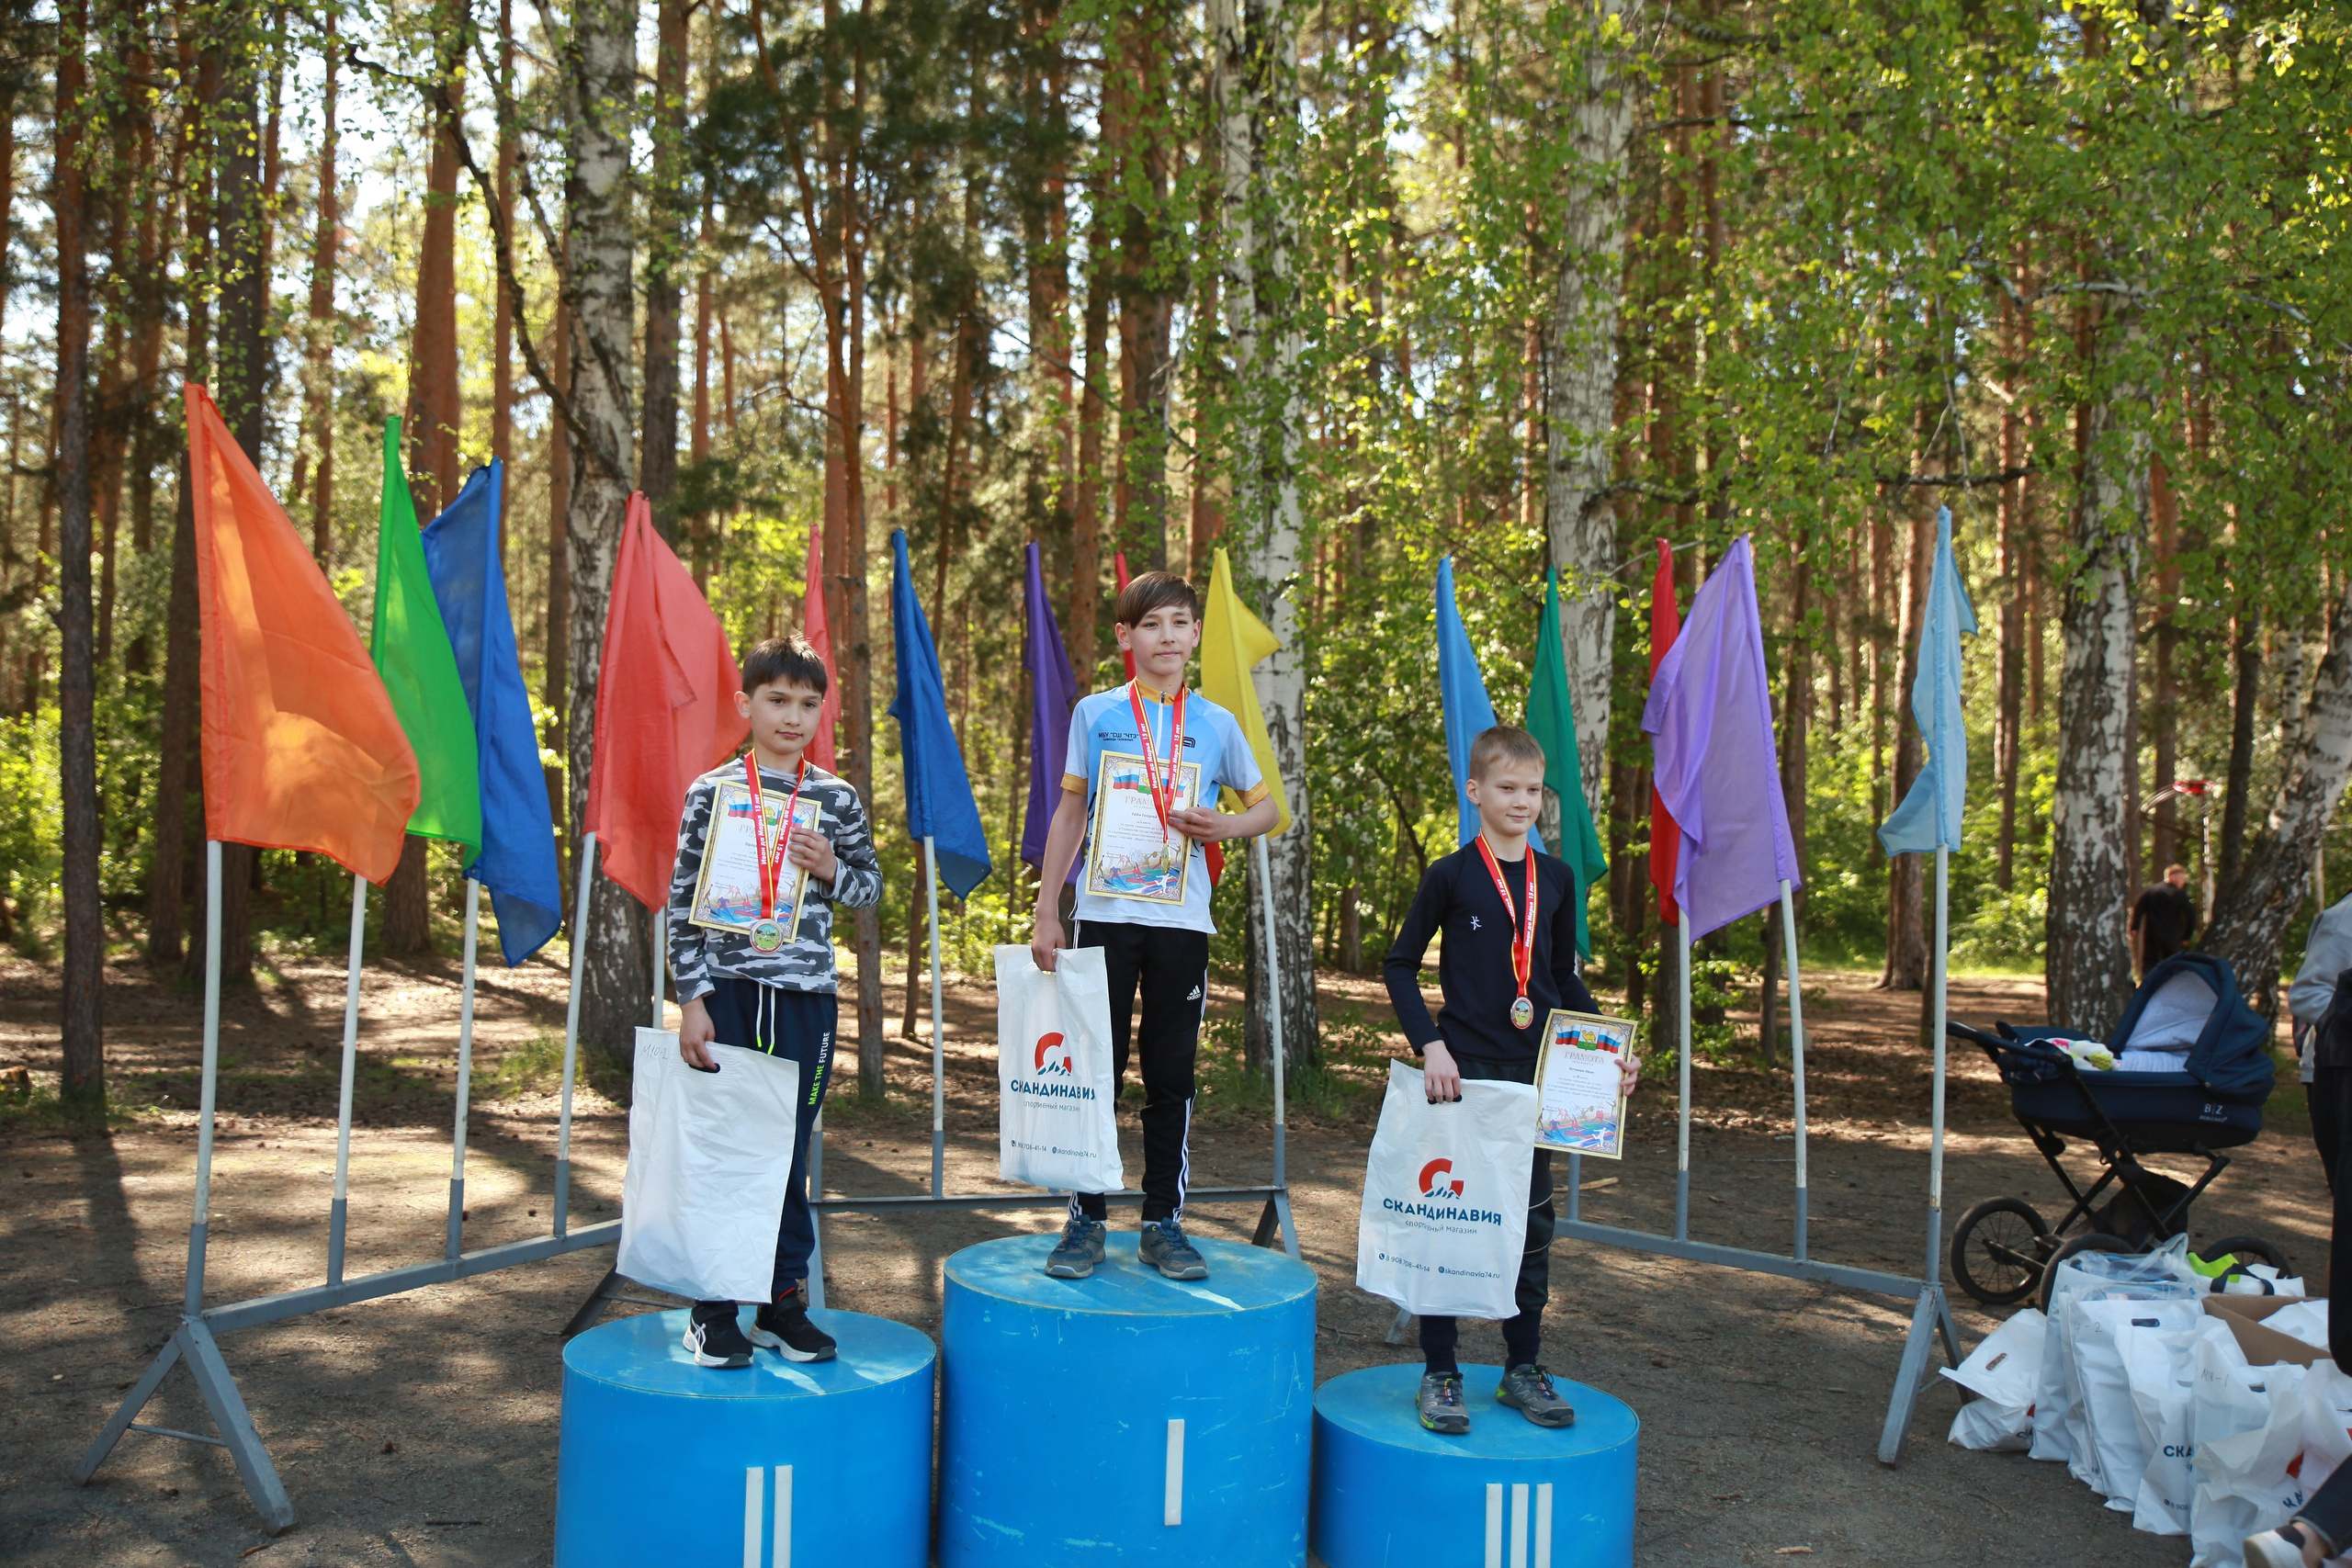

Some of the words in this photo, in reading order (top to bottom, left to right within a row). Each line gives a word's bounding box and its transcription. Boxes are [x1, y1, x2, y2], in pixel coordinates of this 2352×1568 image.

[755, 804, 762, 812] 15
[779, 819, 789, 840] Марья
[760, 837, 766, 846] да
[776, 843, 784, 852] 15
[819, 1032, 831, 1064] FUTURE
[815, 1065, 825, 1081] THE
[808, 1081, 820, 1105] MAKE
[1011, 1079, 1096, 1100] СКАНДИНАВИЯ
[1383, 1198, 1502, 1226] СКАНДИНАВИЯ
[1405, 1220, 1444, 1233] спортивный
[1445, 1225, 1477, 1235] магазин
[1444, 1268, 1500, 1279] skandinavia74.ru
[1164, 1419, 1184, 1526] I
[743, 1464, 793, 1568] II
[1485, 1483, 1553, 1568] III
